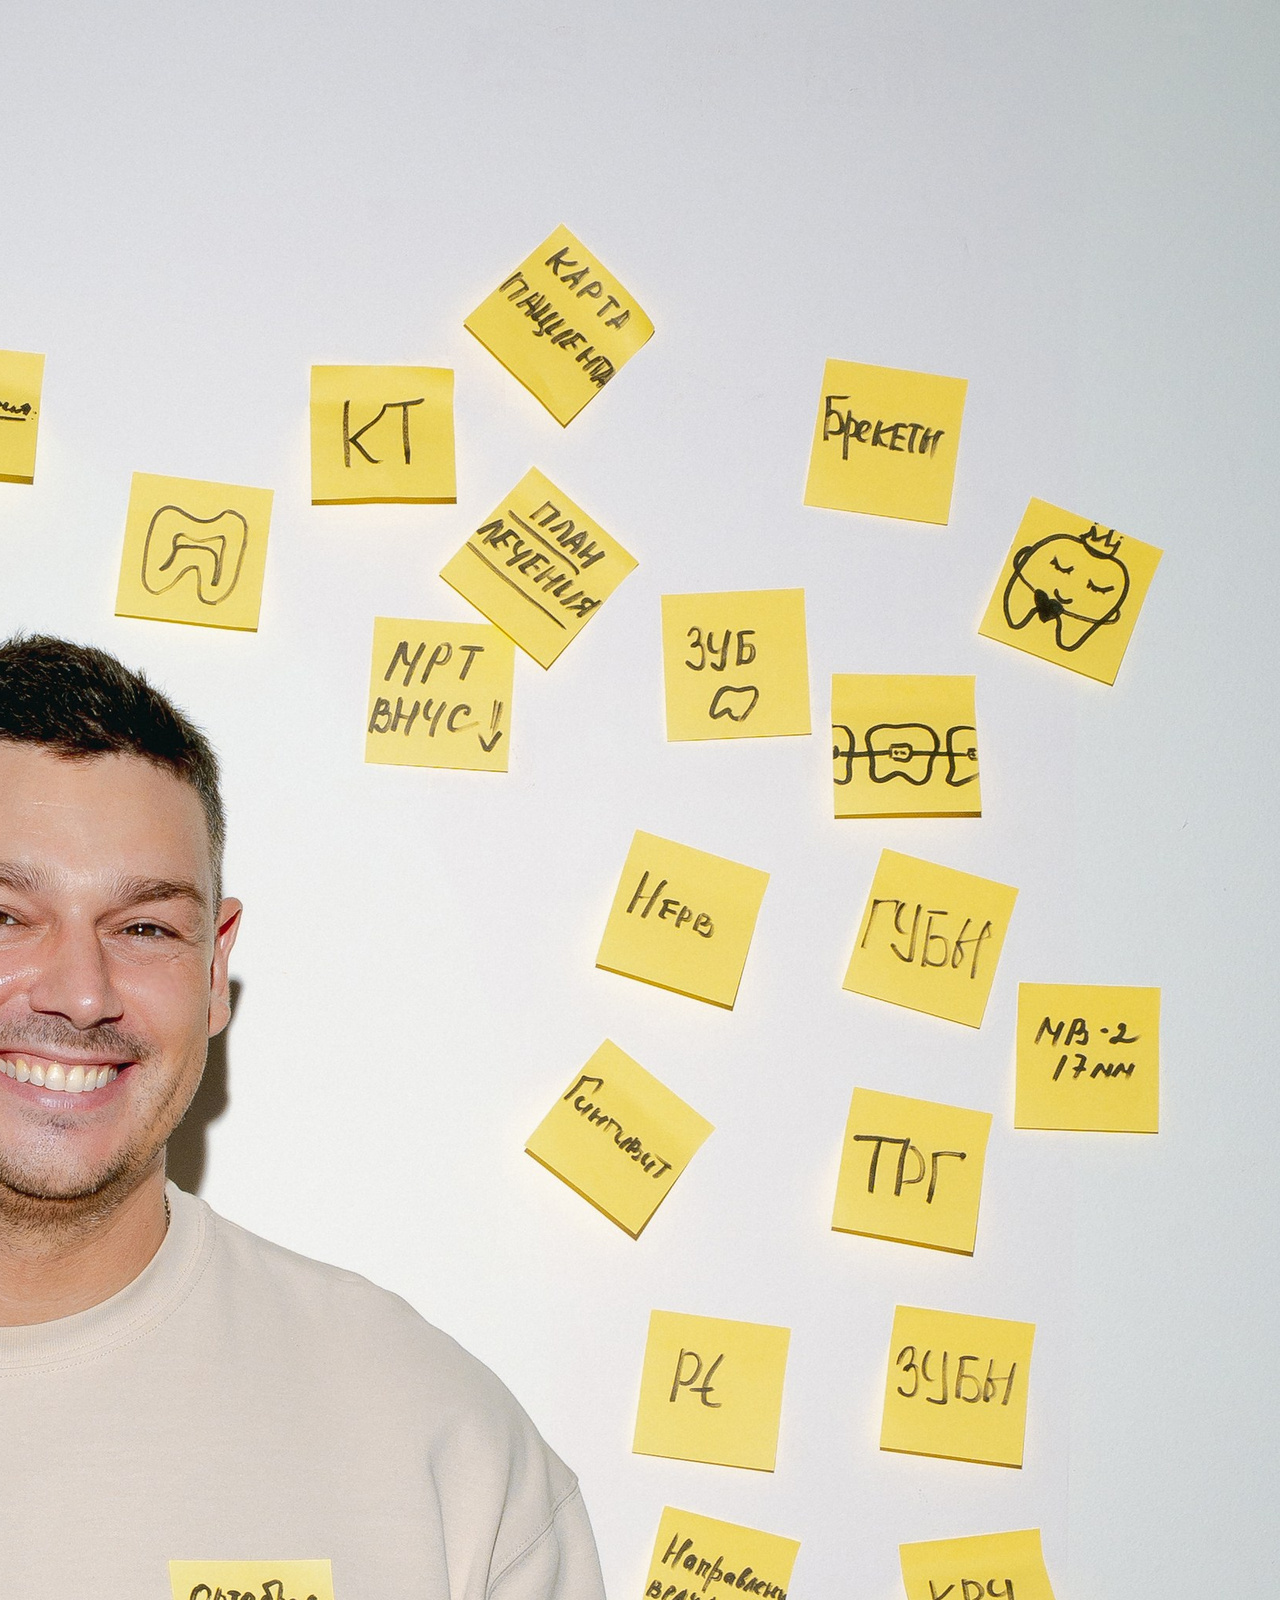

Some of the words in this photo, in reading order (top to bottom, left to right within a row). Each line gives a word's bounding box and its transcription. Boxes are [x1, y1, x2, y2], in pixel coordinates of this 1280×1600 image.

[545, 246, 631, 330] КАРТА
[342, 398, 425, 468] КТ
[476, 518, 602, 619] ЛЕЧЕНИЯ
[529, 500, 605, 570] ПЛАН
[383, 641, 484, 687] МРТ
[685, 626, 756, 671] ЗУБ
[861, 899, 992, 979] ГУБЫ
[853, 1134, 966, 1204] ТРГ
[896, 1345, 1017, 1406] ЗУБЫ
